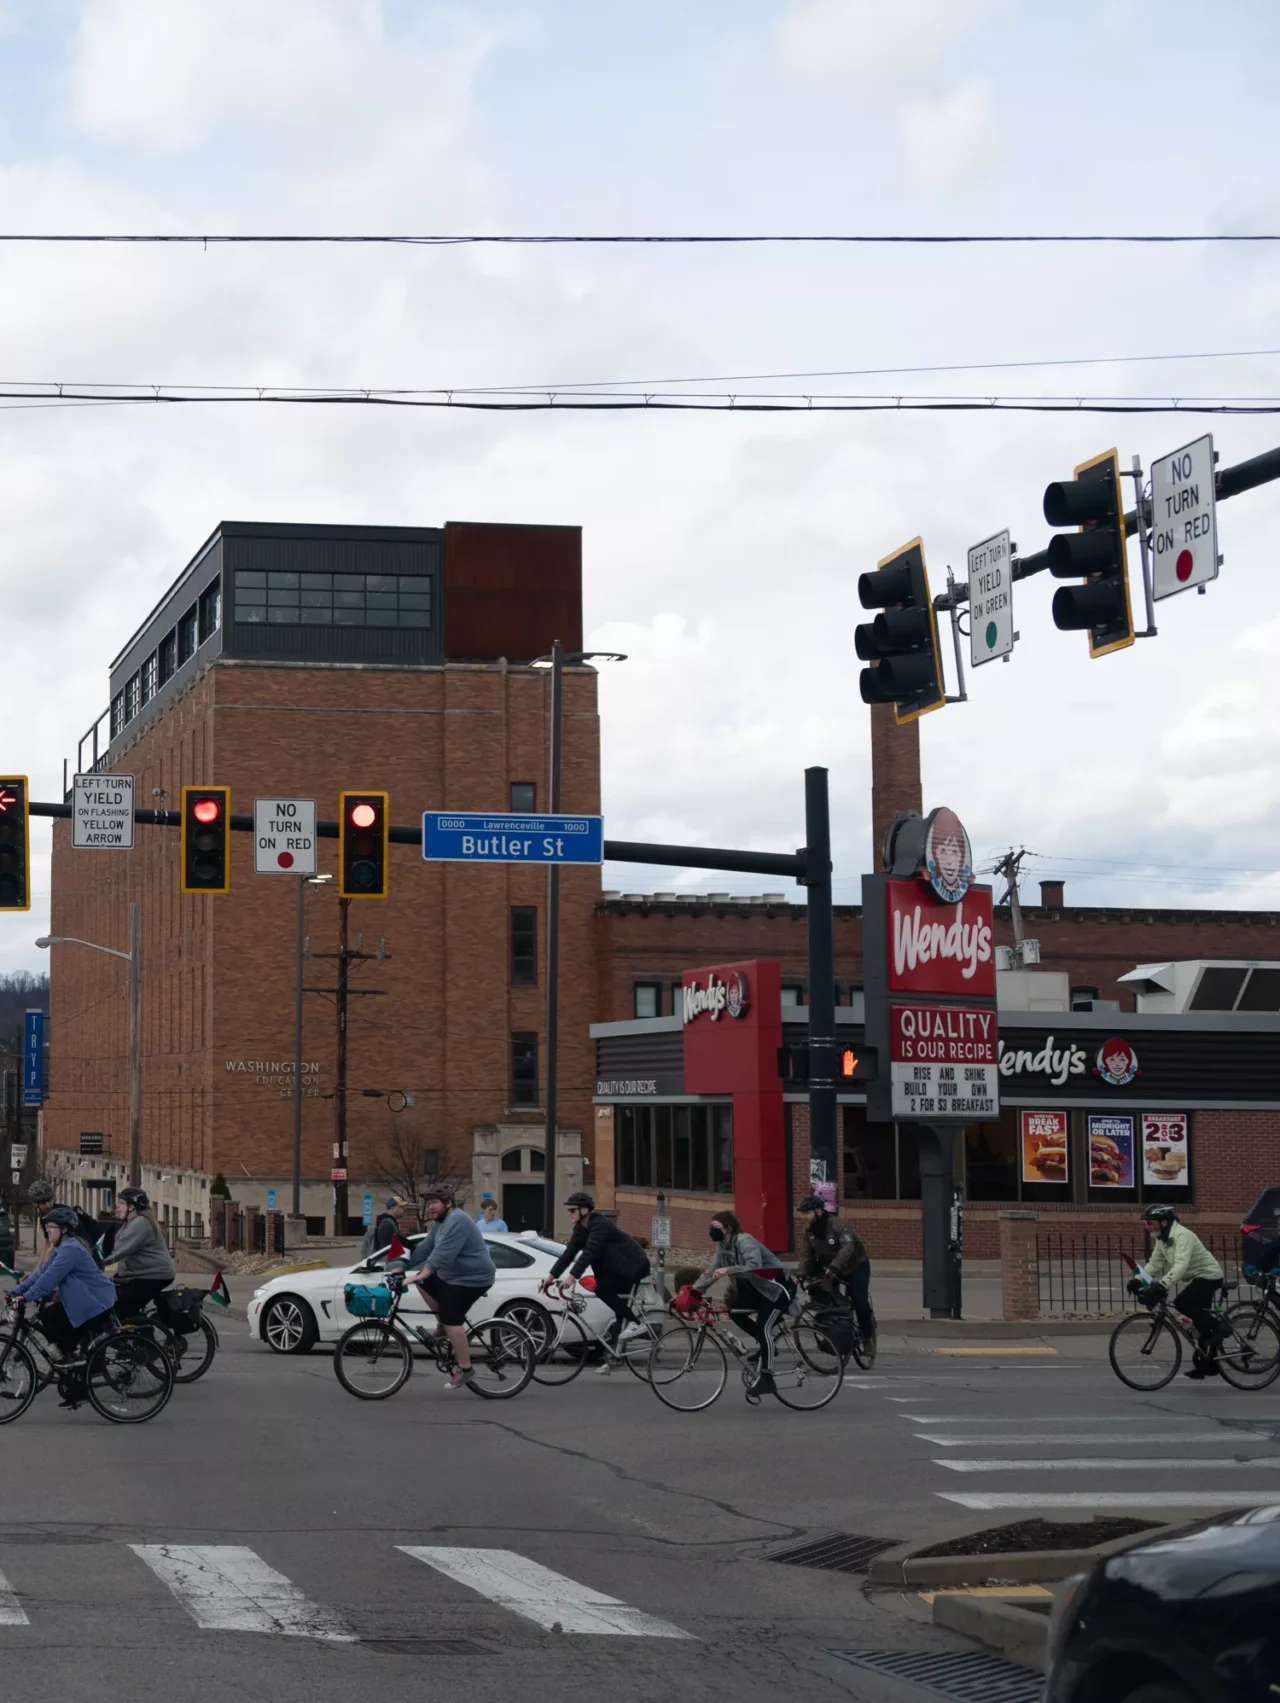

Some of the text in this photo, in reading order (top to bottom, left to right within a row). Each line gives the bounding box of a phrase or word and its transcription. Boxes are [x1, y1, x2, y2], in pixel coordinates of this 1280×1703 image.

[1172, 453, 1192, 485] NO
[1165, 484, 1199, 518] TURN
[1157, 513, 1210, 555] ON RED
[971, 543, 1006, 573] LEFT TURN
[979, 569, 1001, 595] YIELD
[974, 591, 1008, 620] ON GREEN
[75, 779, 132, 789] LEFT TURN
[84, 792, 123, 804] YIELD
[78, 808, 130, 816] ON FLASHING
[276, 803, 297, 817] NO
[82, 820, 124, 830] YELLOW
[269, 821, 301, 833] TURN
[441, 819, 585, 831] 0000 Lawrenceville 1000
[85, 833, 122, 843] ARROW
[259, 837, 311, 850] ON RED
[462, 835, 564, 857] Butler St
[893, 901, 992, 979] Wendy's
[683, 973, 726, 1024] Wendy's
[901, 1010, 991, 1039] QUALITY
[901, 1040, 993, 1059] IS OUR RECIPE
[998, 1036, 1087, 1085] endy's
[256, 1076, 319, 1085] EDUCATON
[913, 1067, 986, 1081] RISE AND SHINE
[280, 1088, 320, 1097] CETER
[904, 1082, 988, 1097] BUILD YOUR OWN
[911, 1099, 916, 1111] 2
[920, 1099, 934, 1111] FOR
[952, 1099, 994, 1112] BREAKFAST
[1029, 1118, 1059, 1126] BREAK
[1091, 1122, 1130, 1130] MIDNIGHT
[1029, 1125, 1060, 1135] FAST
[1145, 1123, 1160, 1142] 2
